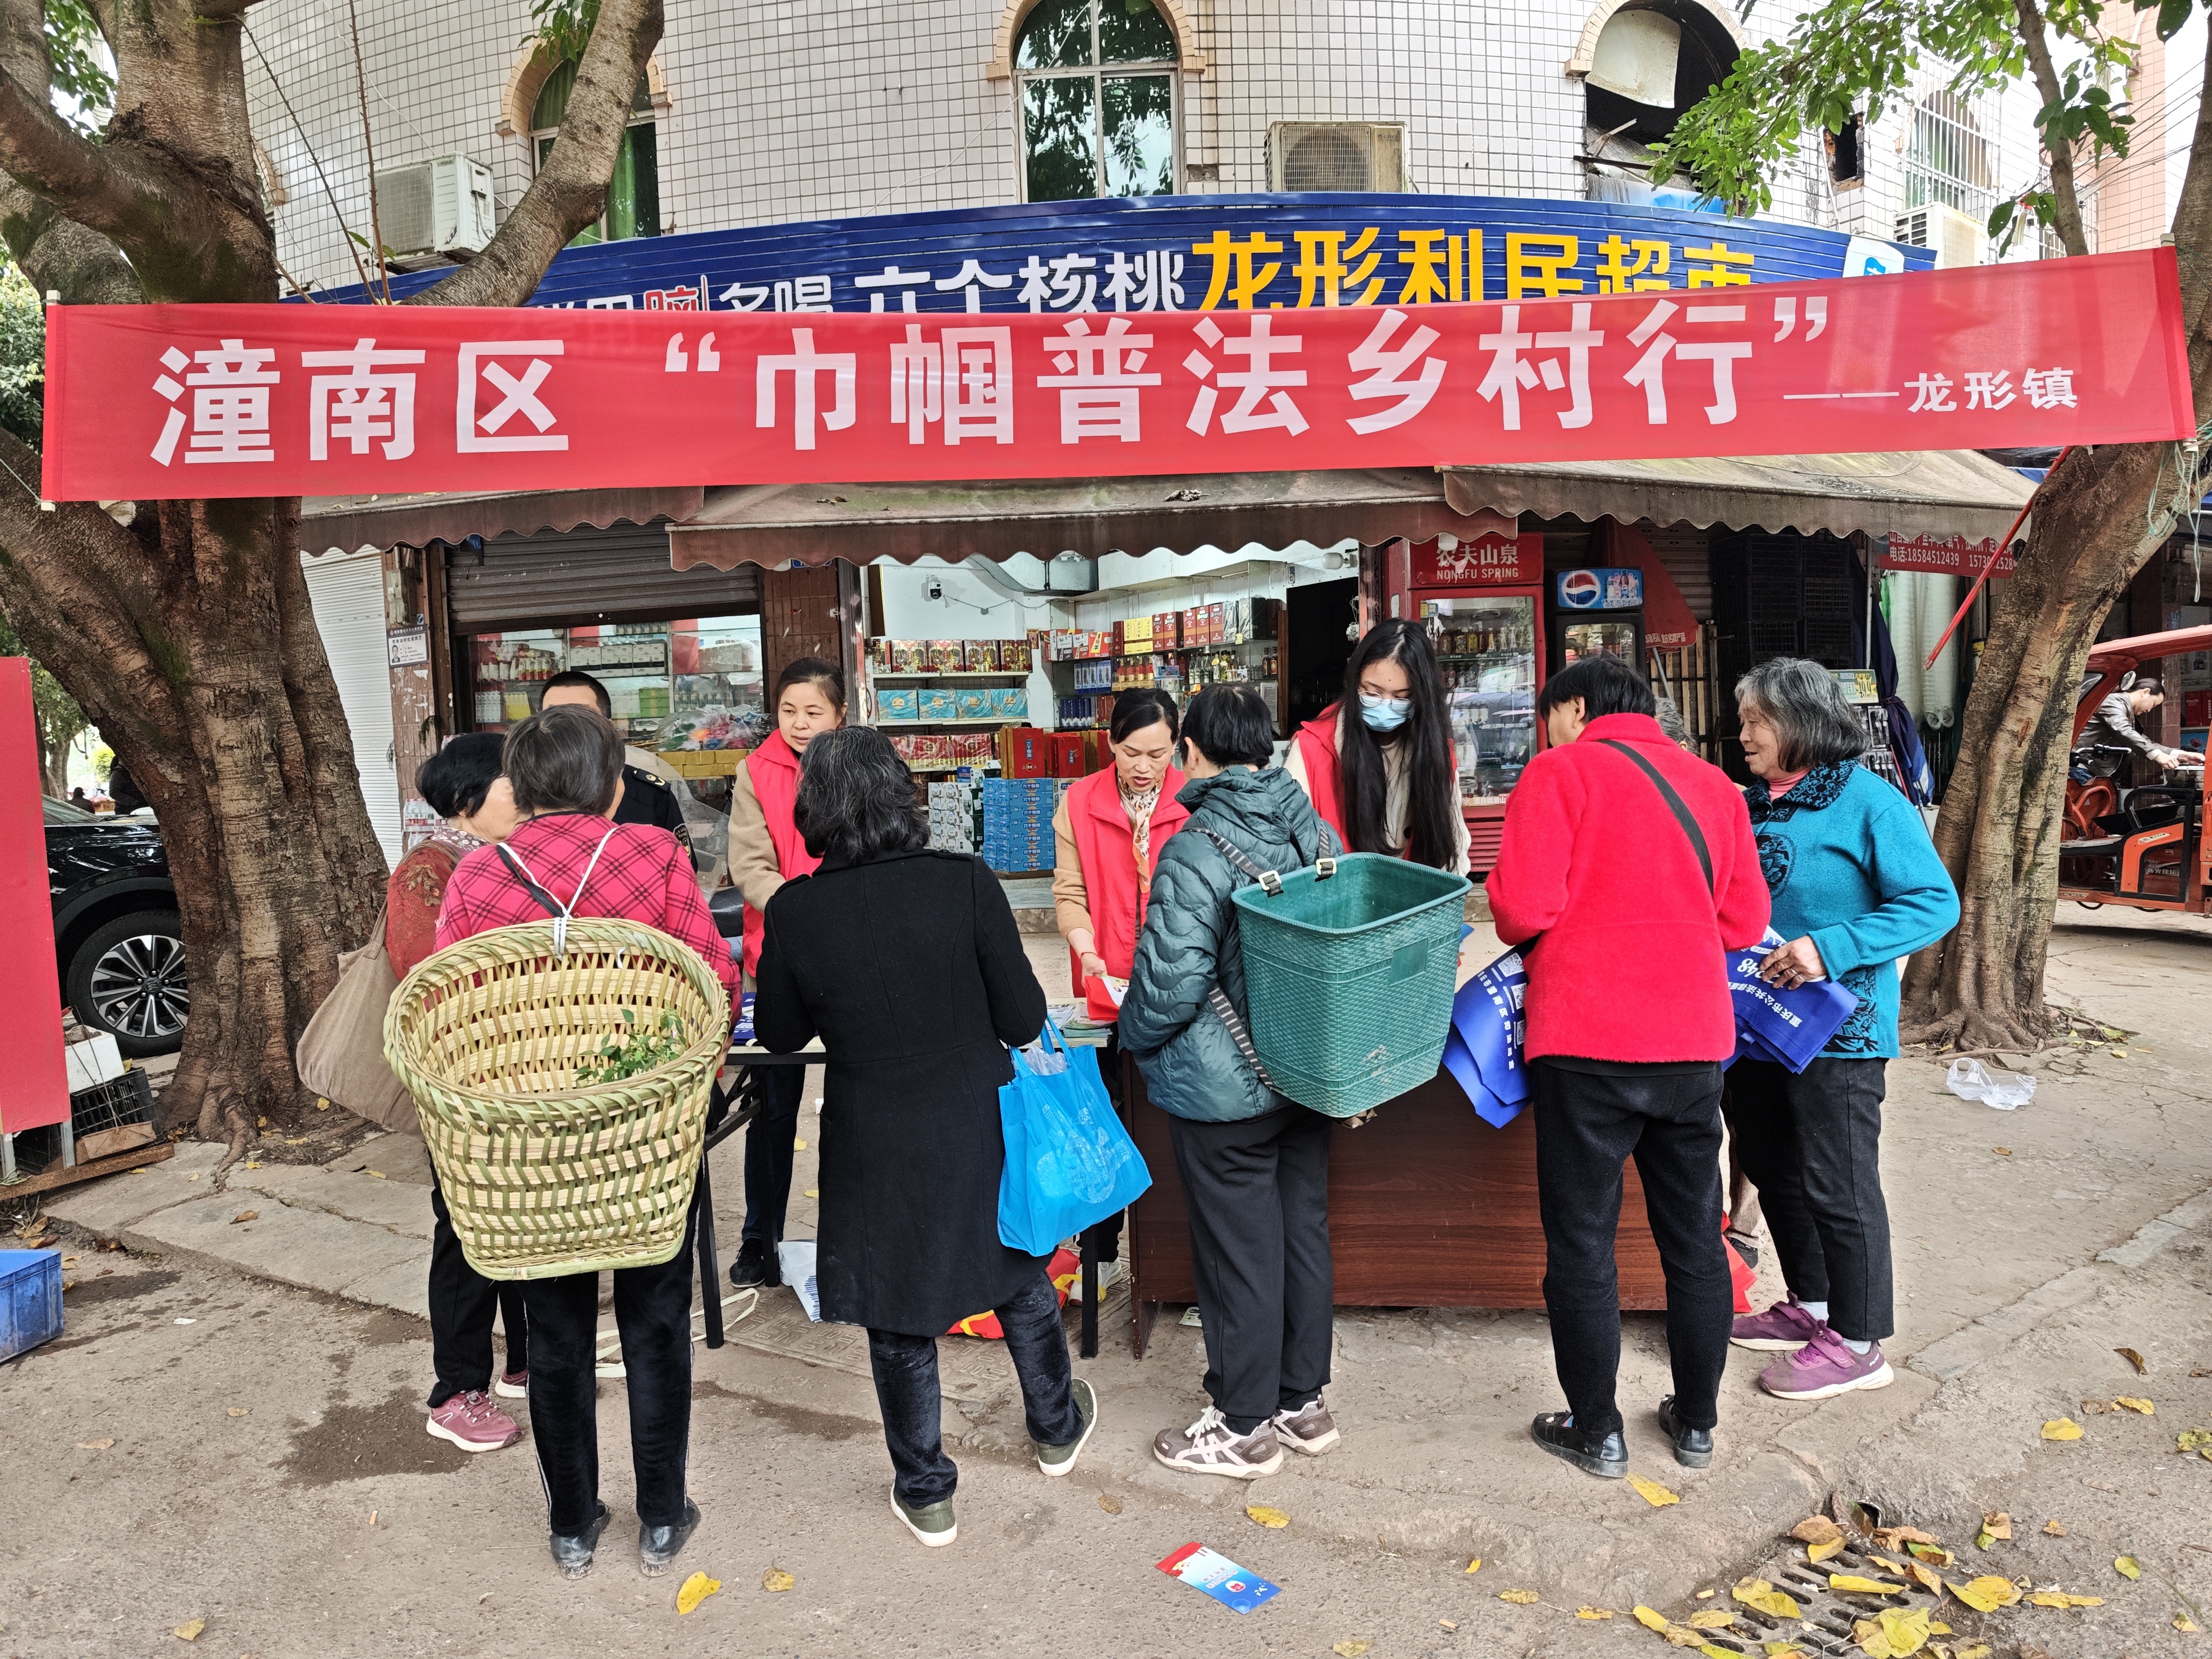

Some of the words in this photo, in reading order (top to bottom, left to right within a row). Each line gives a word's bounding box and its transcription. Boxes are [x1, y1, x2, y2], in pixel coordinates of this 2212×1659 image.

[1435, 543, 1519, 566] 农夫山泉
[1437, 569, 1478, 581] NONGFU
[1481, 567, 1519, 579] SPRING
